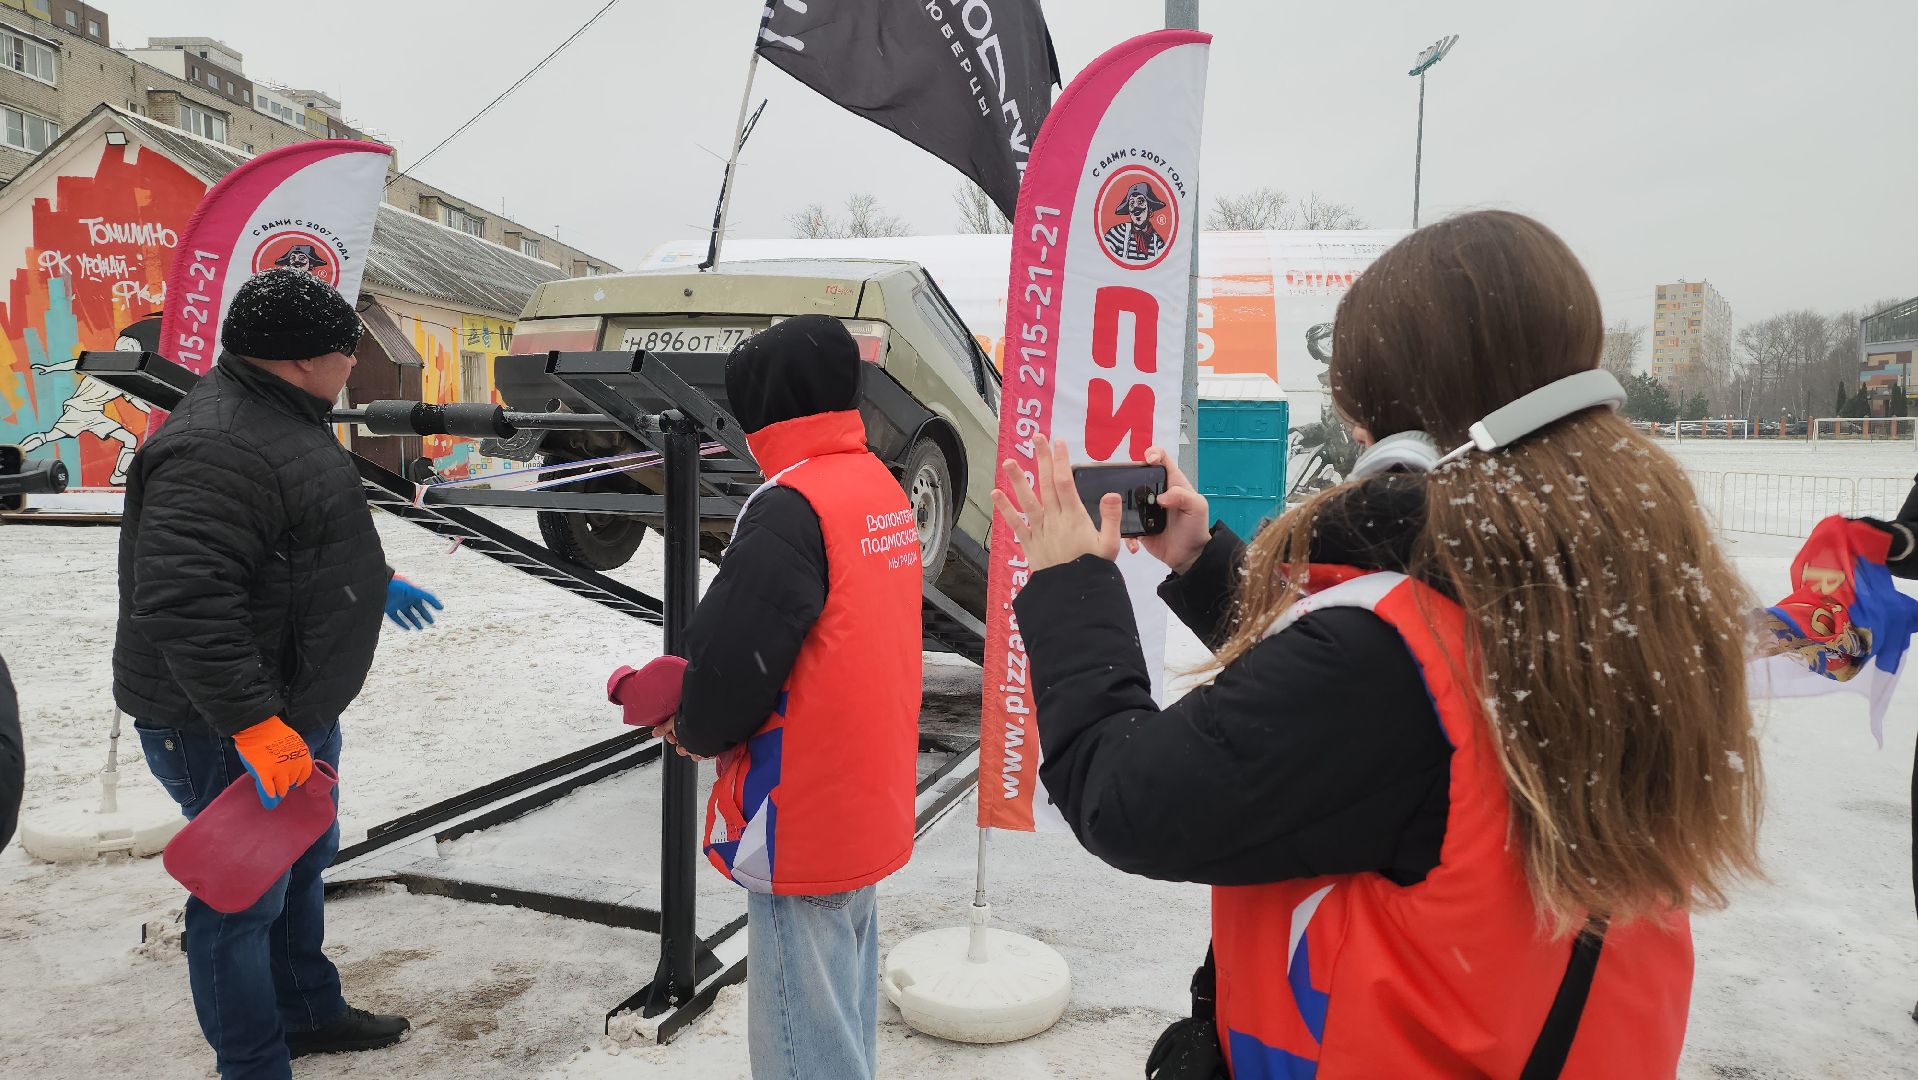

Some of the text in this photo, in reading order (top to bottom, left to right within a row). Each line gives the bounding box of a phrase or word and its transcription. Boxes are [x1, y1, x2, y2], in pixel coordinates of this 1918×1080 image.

[921, 0, 991, 117] ЮБЕРЦЫ
[951, 0, 1030, 187] ОДГУ
[1100, 149, 1127, 169] ВАМИ
[1140, 149, 1167, 167] 2007
[261, 218, 292, 232] ВАМИ
[306, 221, 332, 236] 2007
[332, 236, 351, 262] ГОДА
[723, 329, 745, 346] 77
[1014, 205, 1060, 460] 495 215-21-21
